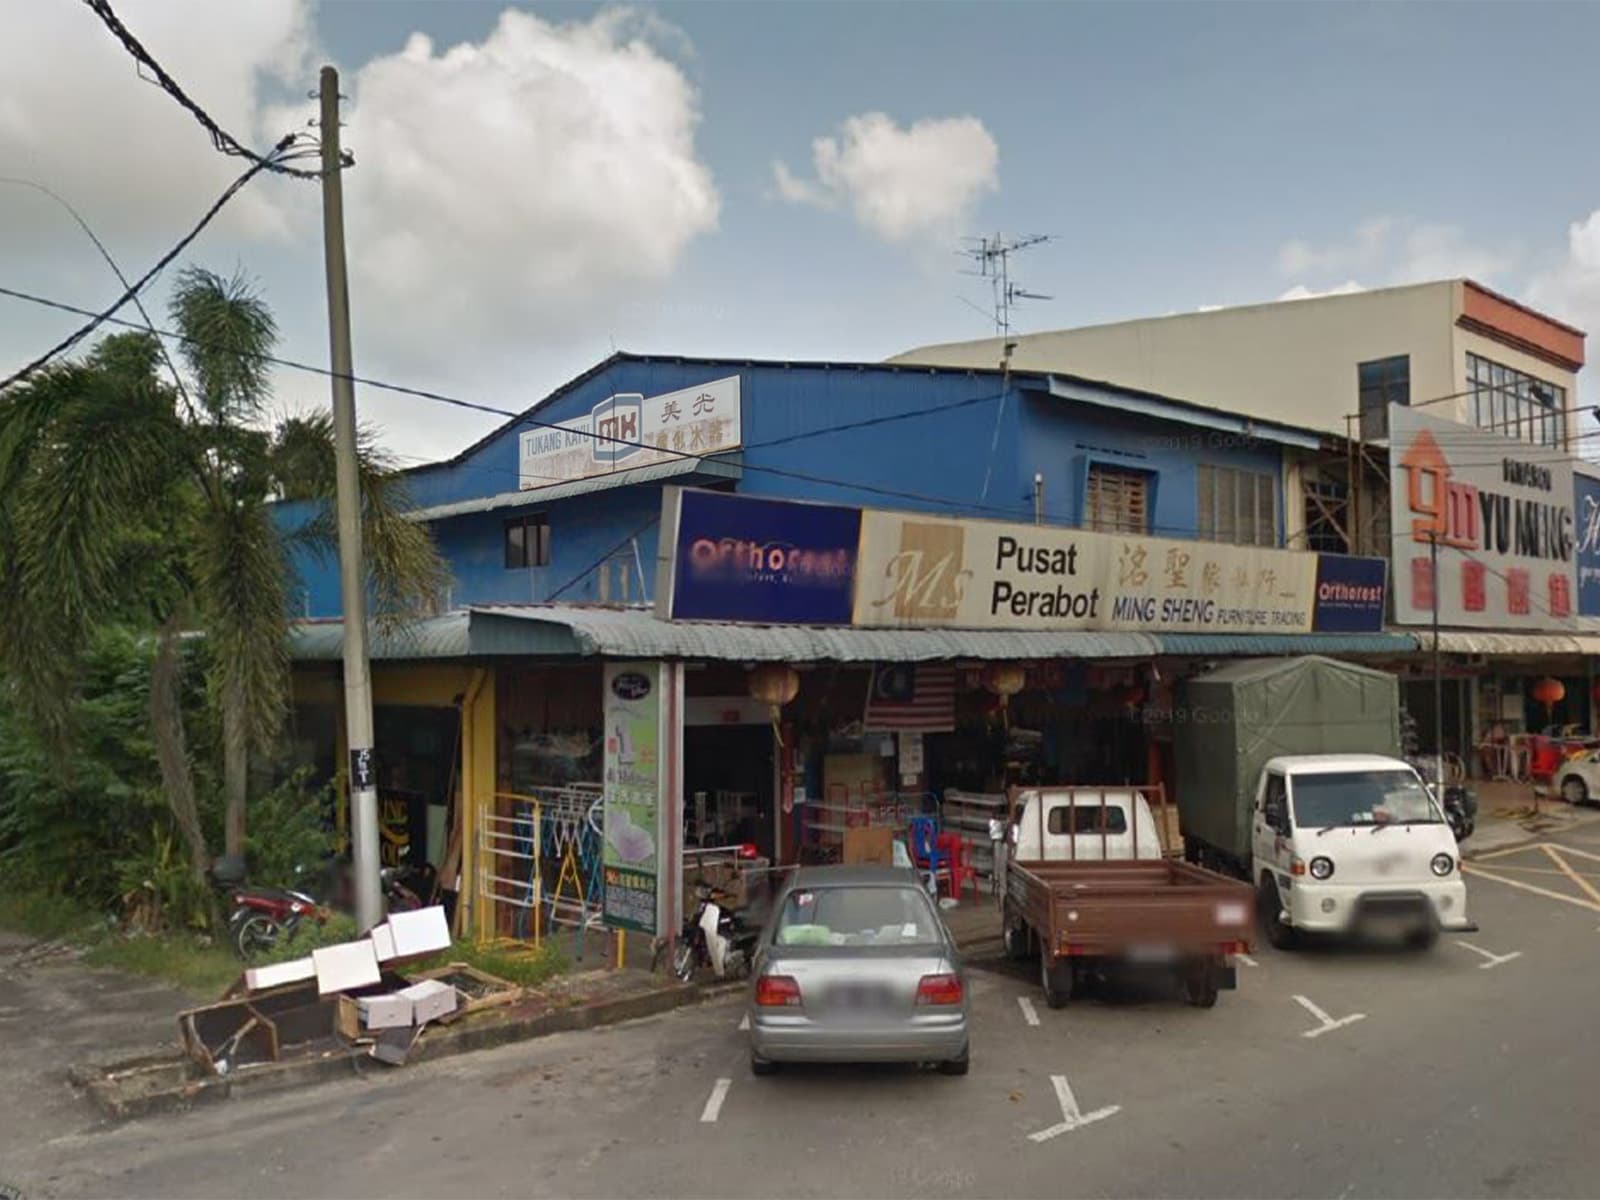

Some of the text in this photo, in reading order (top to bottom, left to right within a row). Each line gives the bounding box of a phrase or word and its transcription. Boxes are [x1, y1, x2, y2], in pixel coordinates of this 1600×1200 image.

[526, 423, 590, 457] TUKANG KAYU
[996, 536, 1077, 575] Pusat
[991, 581, 1099, 618] Perabot
[1319, 582, 1382, 601] Orthorest
[1112, 597, 1157, 623] MING
[1161, 598, 1215, 624] SHENG
[1271, 610, 1306, 626] TRADING
